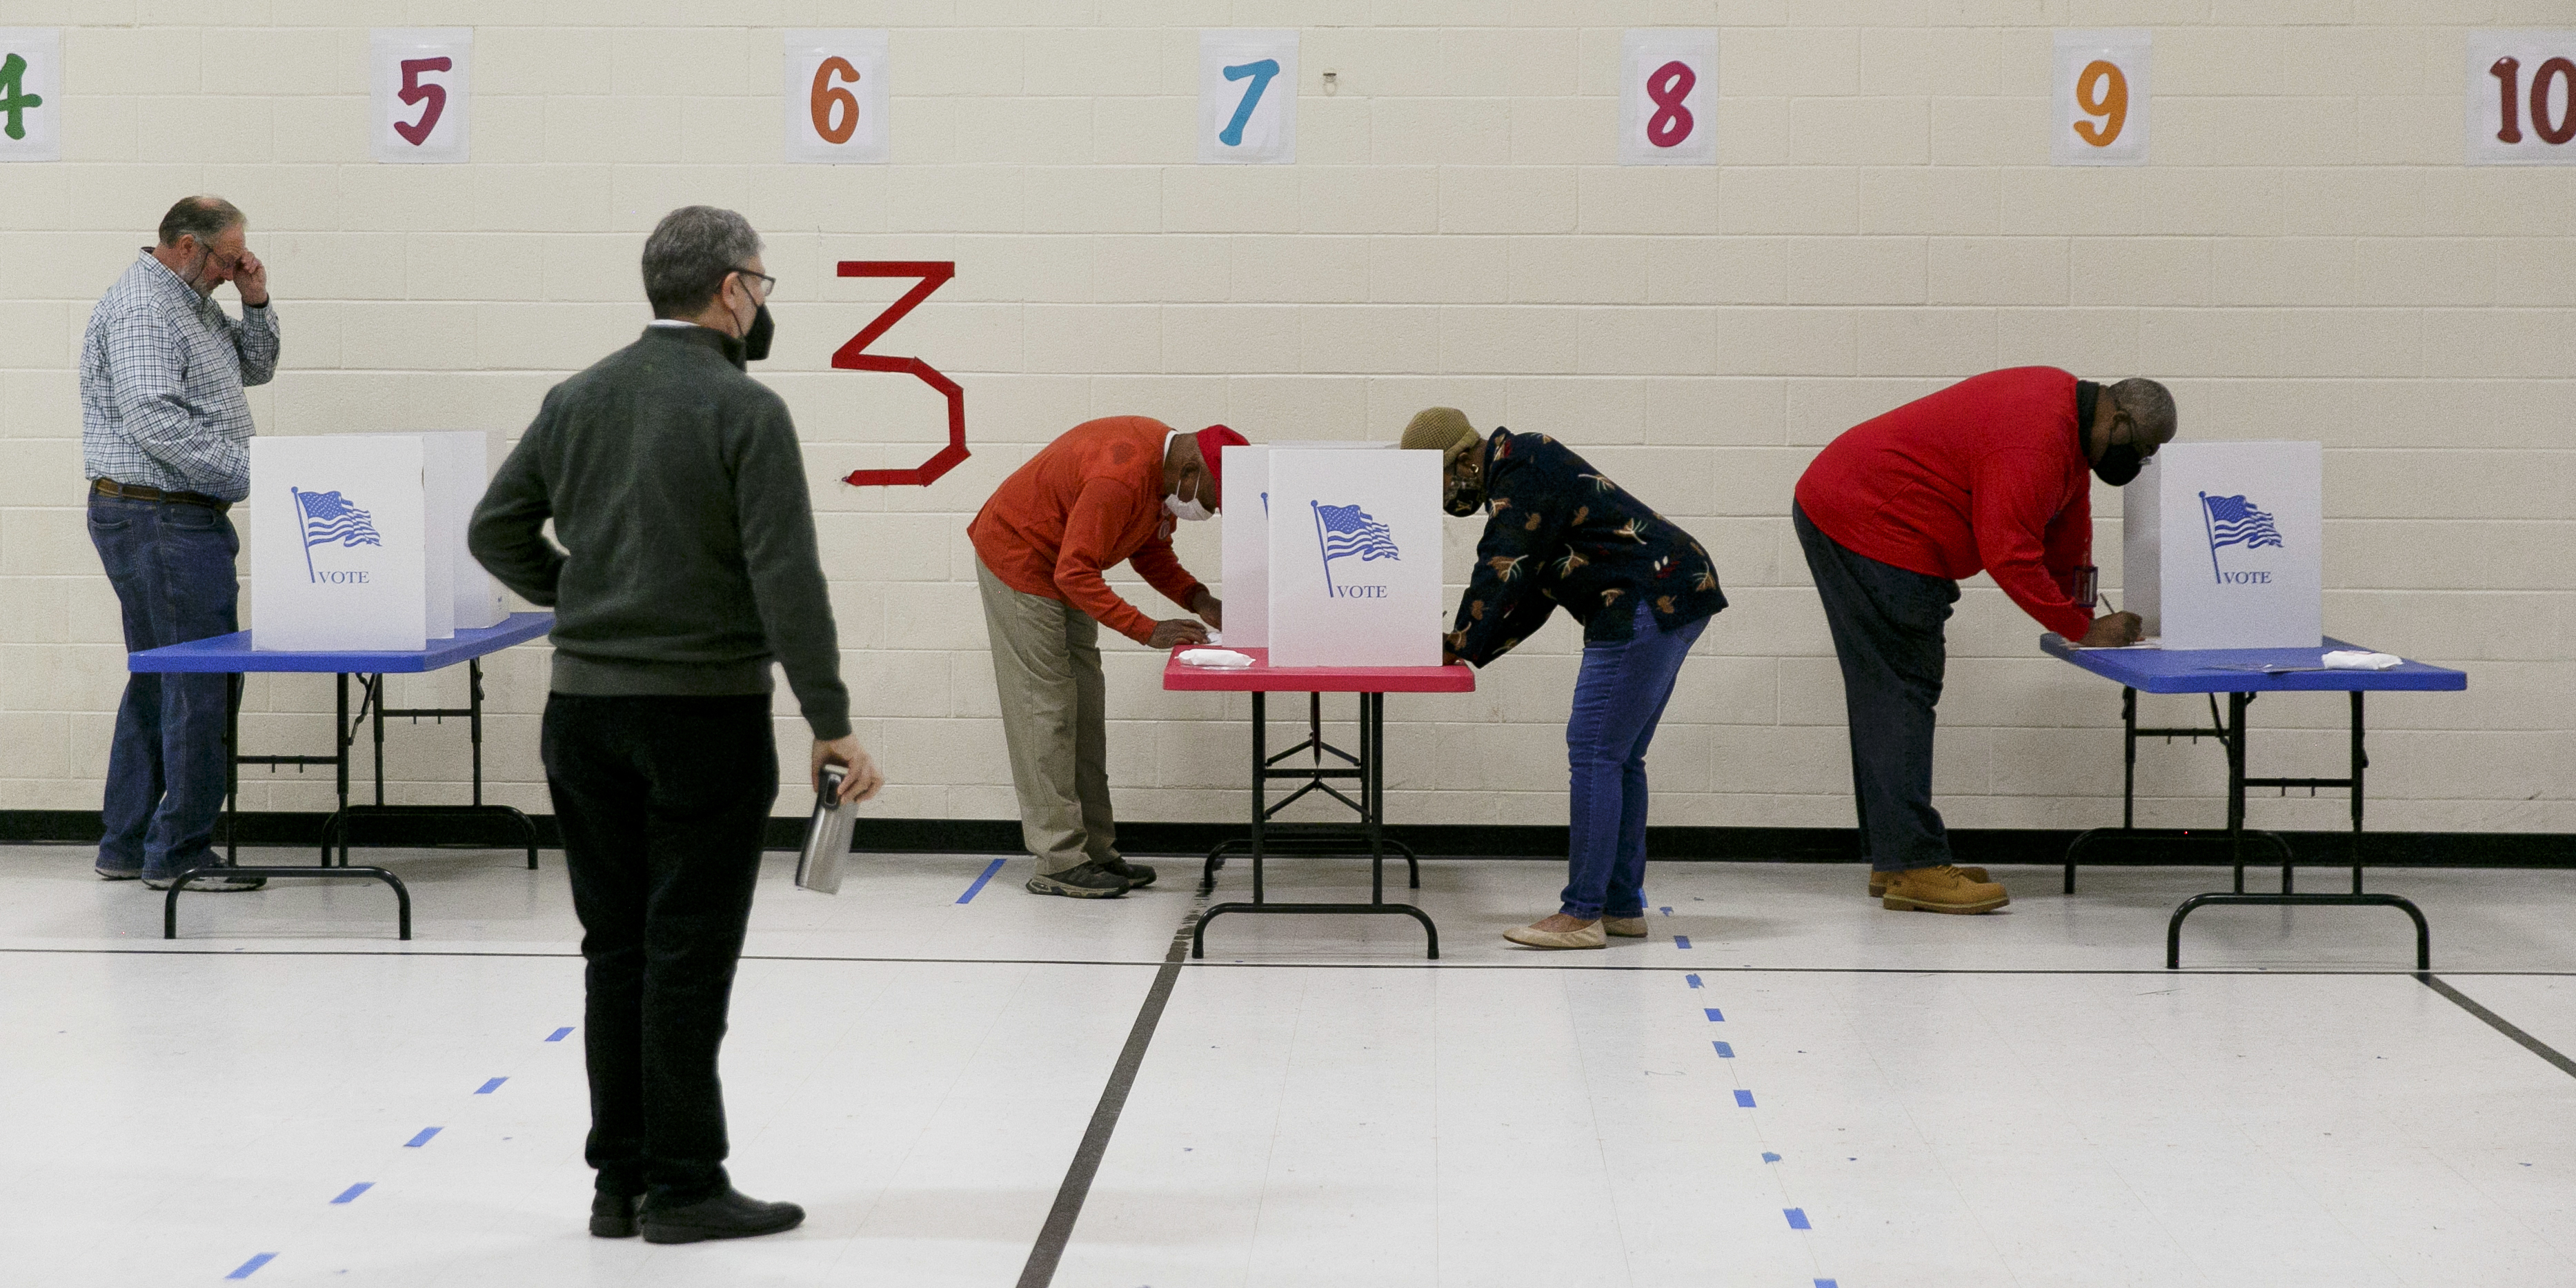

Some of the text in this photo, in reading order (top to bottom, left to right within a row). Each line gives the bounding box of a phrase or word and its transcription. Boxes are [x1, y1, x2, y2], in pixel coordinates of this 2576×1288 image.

[0, 53, 43, 140] 4
[393, 57, 453, 146] 5
[811, 56, 860, 145] 6
[1218, 59, 1280, 146] 7
[1646, 60, 1696, 148] 8
[2073, 59, 2128, 148] 9
[2489, 56, 2576, 145] 10
[831, 261, 971, 487] 3
[317, 569, 370, 582] VOTE
[1336, 584, 1389, 597] VOTE
[2223, 570, 2273, 582] VOTE
